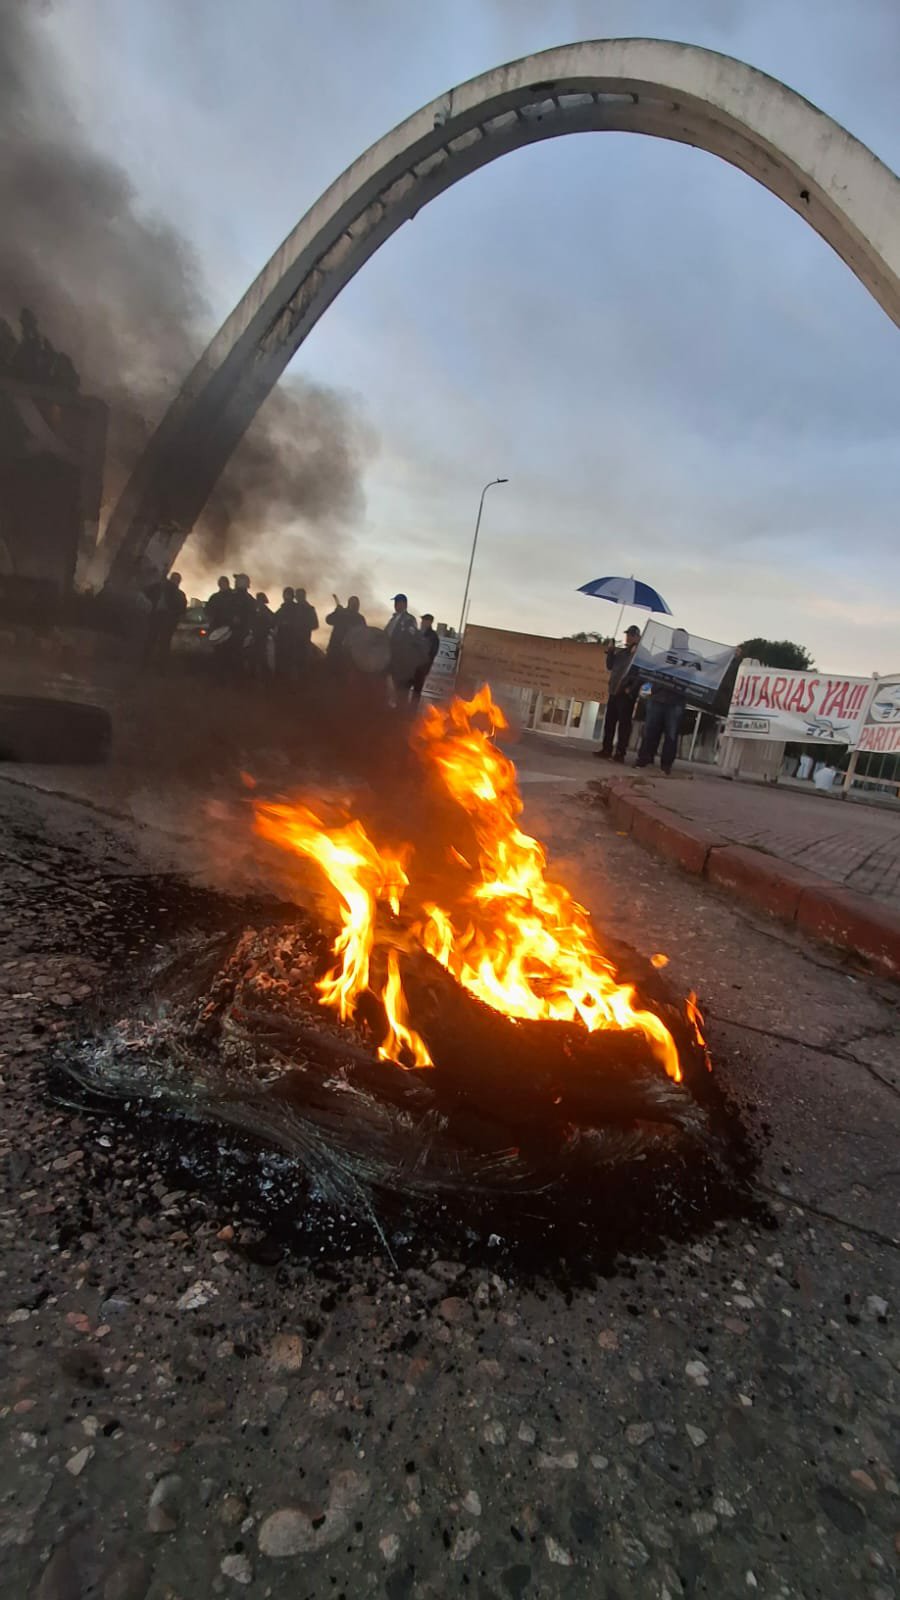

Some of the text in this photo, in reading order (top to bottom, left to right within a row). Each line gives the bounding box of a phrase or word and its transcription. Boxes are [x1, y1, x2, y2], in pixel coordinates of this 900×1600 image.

[665, 655, 702, 672] STA
[818, 680, 869, 720] YA!!!
[806, 727, 834, 738] STA
